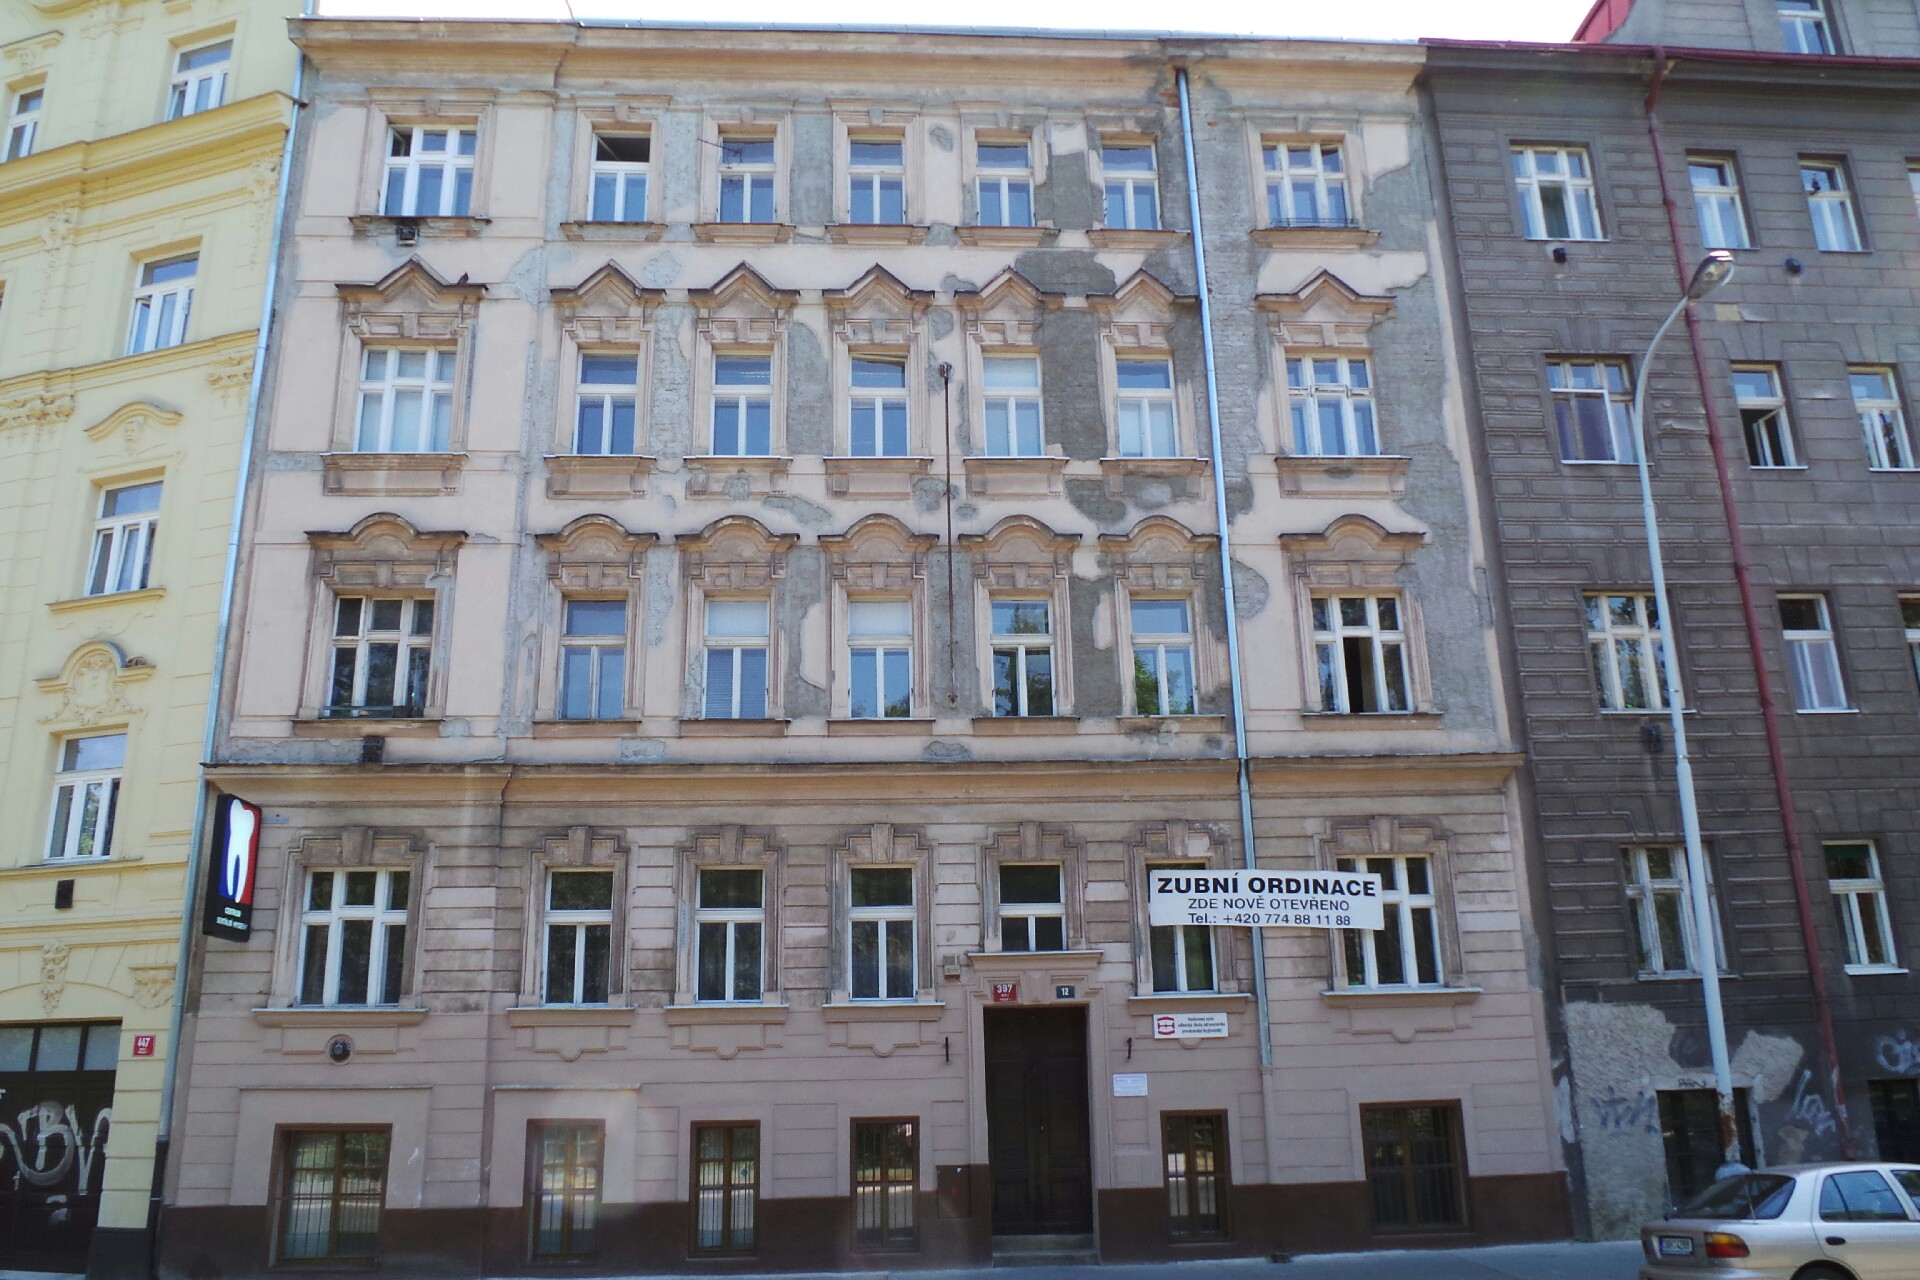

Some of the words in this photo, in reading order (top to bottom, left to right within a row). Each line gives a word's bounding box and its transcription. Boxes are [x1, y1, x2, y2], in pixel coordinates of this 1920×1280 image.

[1157, 872, 1239, 894] ZUBNÍ
[1247, 877, 1376, 897] ORDINACE
[1187, 898, 1218, 909] ZDE
[1223, 895, 1265, 910] NOVĚ
[1269, 896, 1350, 911] OTEVŘENO
[1187, 912, 1217, 924] Tel.:
[1223, 913, 1260, 924] +420
[1264, 913, 1290, 924] 774
[1294, 914, 1311, 925] 88
[1316, 915, 1330, 925] 11
[1336, 915, 1351, 926] 88
[997, 984, 1013, 994] 397
[1061, 987, 1069, 996] 12
[137, 1037, 151, 1048] 447
